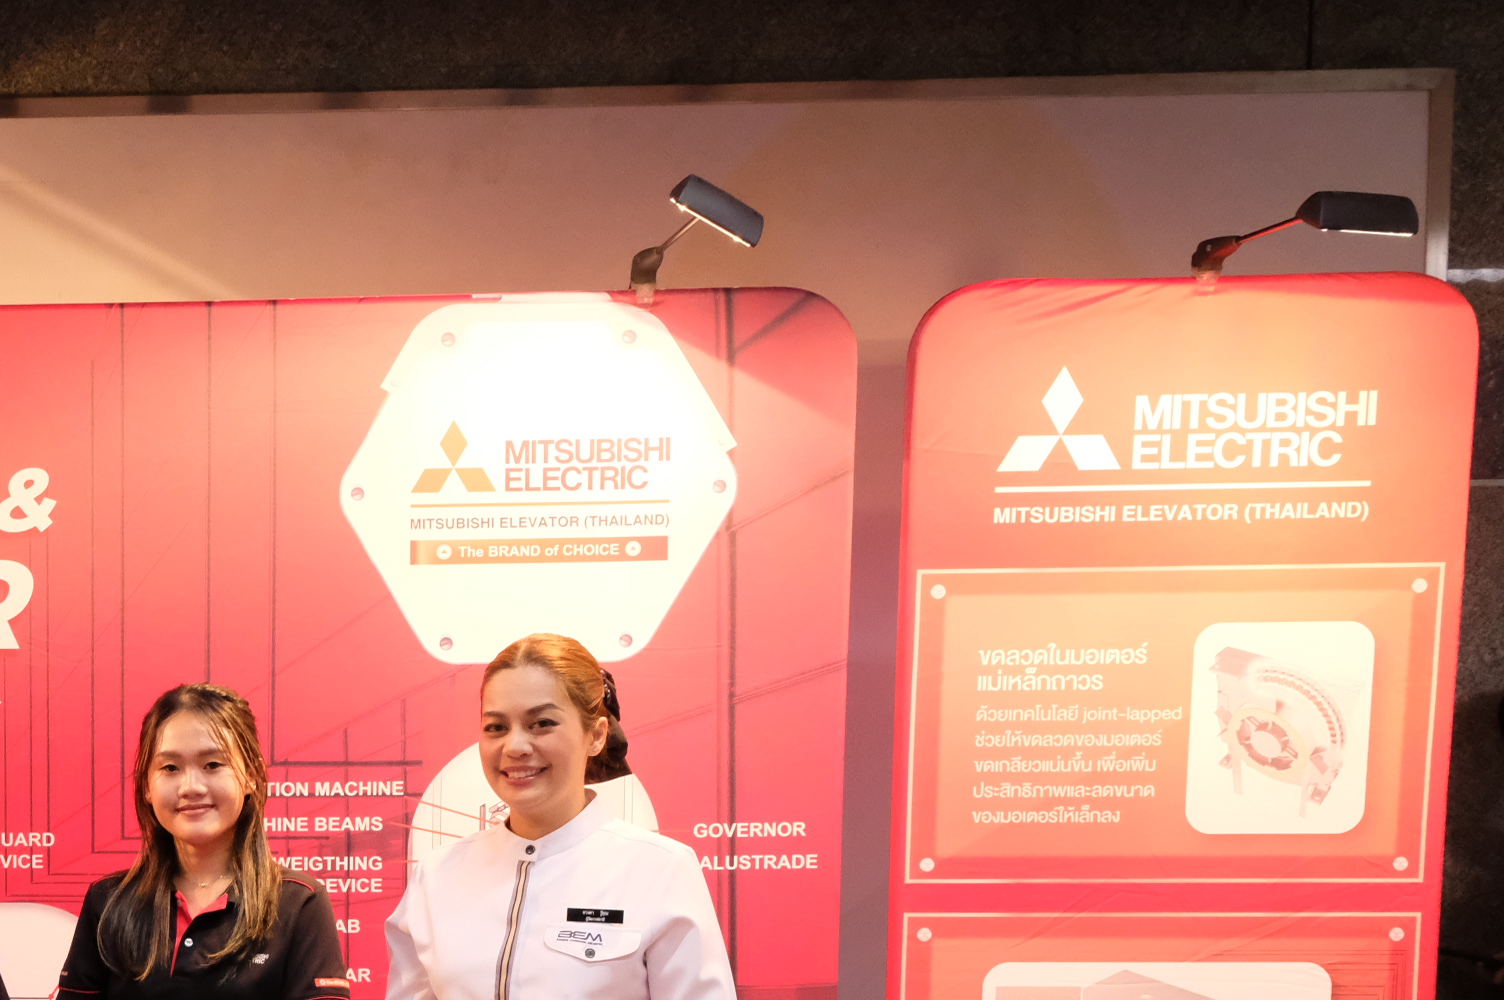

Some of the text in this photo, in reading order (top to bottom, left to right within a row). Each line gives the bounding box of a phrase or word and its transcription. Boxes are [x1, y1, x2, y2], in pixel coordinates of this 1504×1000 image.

[1133, 390, 1378, 430] MITSUBISHI
[505, 437, 671, 465] MITSUBISHI
[1132, 430, 1343, 470] ELECTRIC
[505, 466, 649, 492] ELECTRIC
[410, 512, 670, 530] MITSUBISHI ELEVATOR (THAILAND)
[993, 500, 1369, 524] MITSUBISHI ELEVATOR (THAILAND)
[458, 543, 619, 557] The BRAND of CHOICE
[978, 642, 1148, 665] ขดลวดในมอเตอร์
[977, 667, 1103, 691] แม่เหล็กถาวร
[976, 704, 1182, 723] ด้วยเทคโนโลยี joint-lapped
[975, 730, 1163, 747] ช่วยให้ขดลวดของมอเตอร์
[974, 752, 1156, 772] ขดเกลียวแน่นขึ้น เพื่อเพิ่ม
[267, 781, 404, 797] TION MACHINE
[973, 782, 1155, 798] ประสิทธิภาพและลดขนาด
[972, 805, 1120, 823] ของมอเตอร์ให้เล็กลง
[264, 816, 383, 831] HINE BEAMS
[693, 822, 806, 838] GOVERNOR
[698, 854, 818, 870] ALUSTRADE
[316, 878, 382, 892] EVICE
[336, 919, 360, 933] AB
[346, 968, 371, 982] AR
